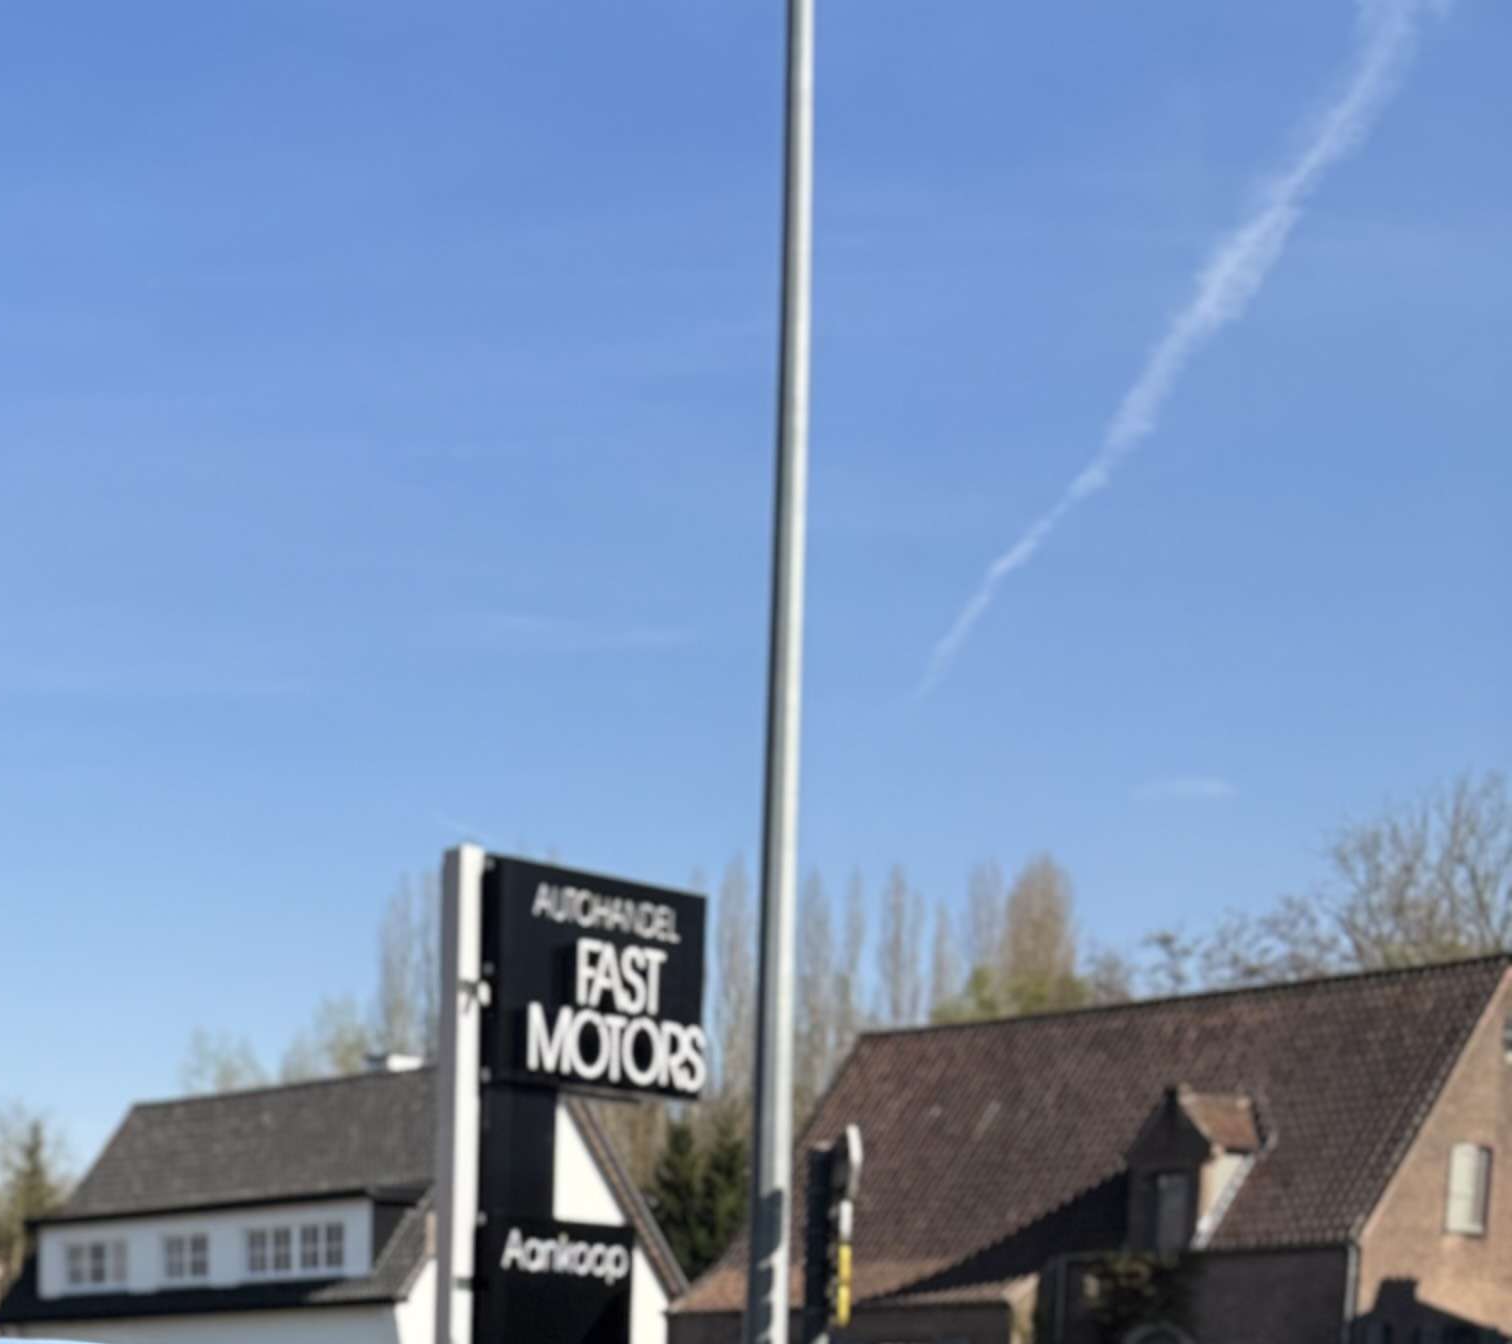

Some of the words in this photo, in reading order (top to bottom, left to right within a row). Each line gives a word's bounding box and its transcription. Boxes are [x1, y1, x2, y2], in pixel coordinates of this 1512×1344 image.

[531, 882, 681, 944] AUTOHANDEL
[576, 937, 668, 1016] FAST
[526, 1002, 706, 1092] MOTORS
[500, 1227, 629, 1286] Aankoop
